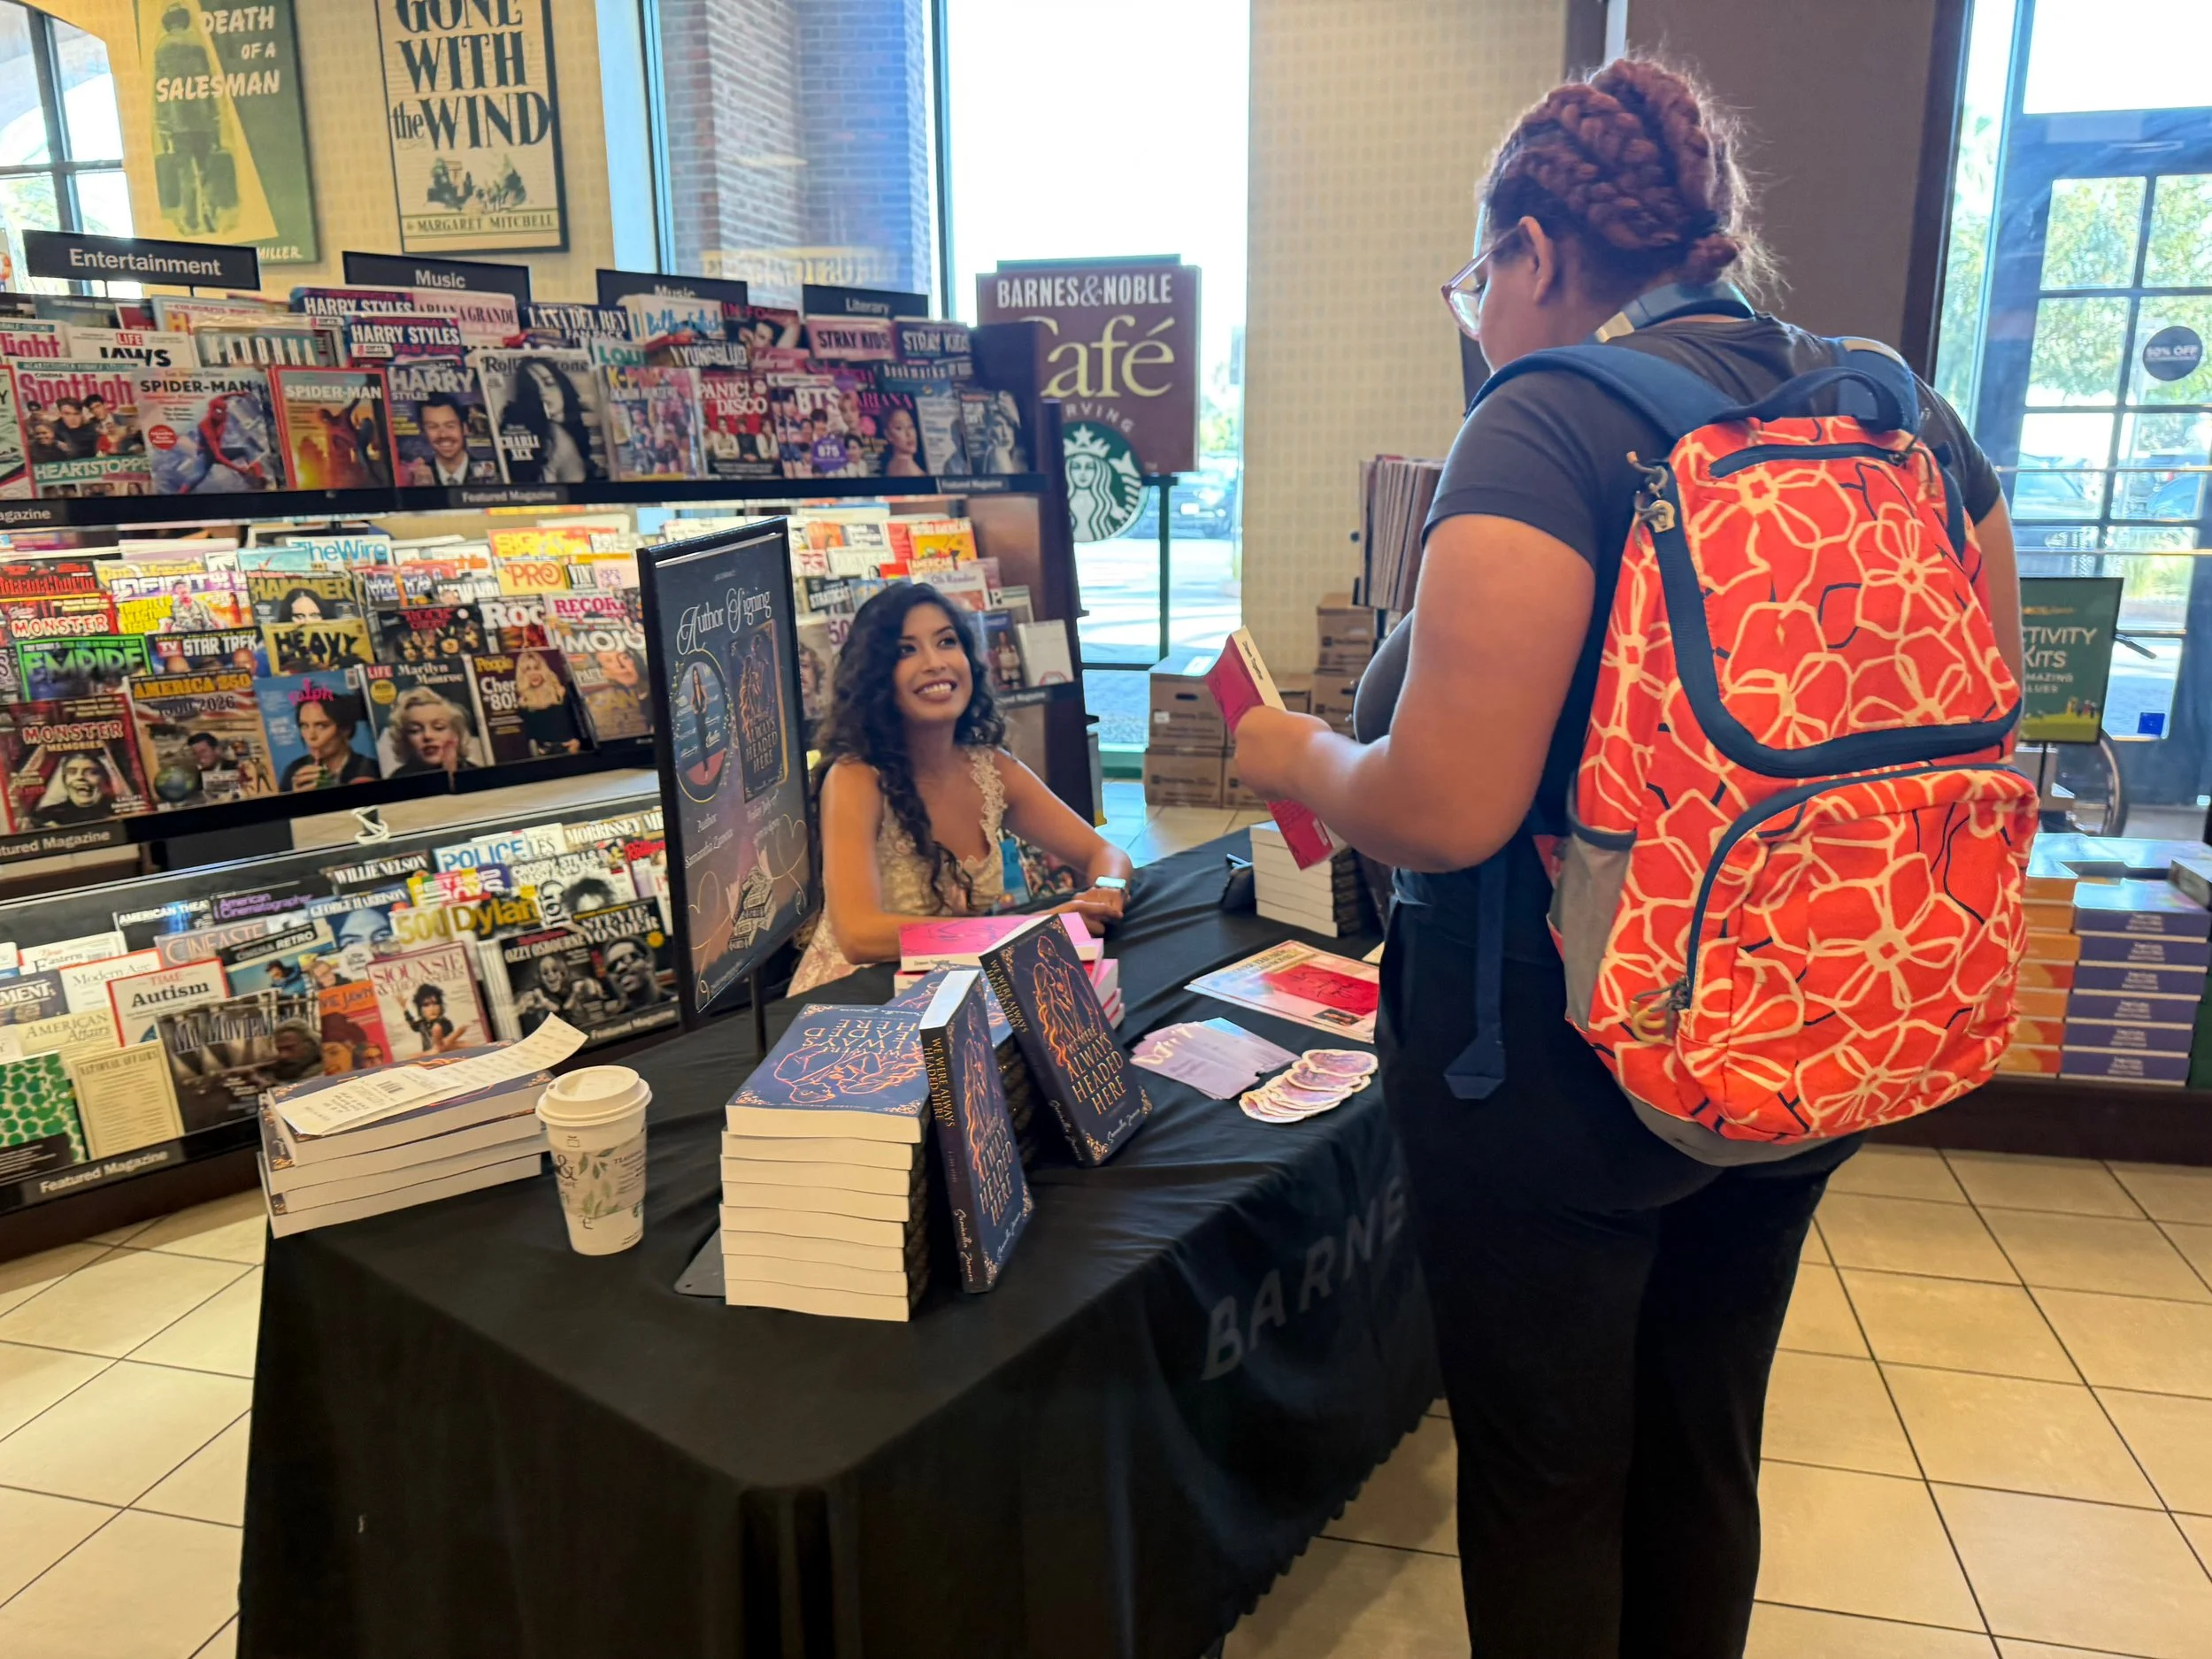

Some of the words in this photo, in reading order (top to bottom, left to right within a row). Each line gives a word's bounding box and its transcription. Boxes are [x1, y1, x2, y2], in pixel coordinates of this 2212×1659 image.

[198, 7, 274, 35] DEATH
[241, 42, 261, 60] OF
[264, 42, 277, 59] A
[399, 31, 526, 94] WITH
[155, 70, 280, 103] SALESMAN
[393, 107, 426, 142] the
[421, 91, 551, 151] WIND
[417, 216, 483, 233] MARGARET
[489, 213, 554, 229] MITCHELL
[70, 248, 222, 278] Entertainment
[256, 245, 303, 261] MILLER
[415, 269, 466, 289] Music
[996, 273, 1173, 309] BARNES&NOBLE
[303, 296, 357, 316] HARRY
[845, 296, 892, 315] Literary
[116, 333, 143, 346] LIFE
[350, 324, 405, 343] HARRY
[408, 326, 461, 345] STYLES
[140, 380, 251, 392] SPIDER-MAN
[284, 384, 382, 399] SPIDER-MAN
[388, 365, 474, 395] HARRY
[716, 397, 768, 416] DISCO
[12, 614, 109, 638] MONSTER
[676, 602, 725, 656] Author
[726, 588, 772, 634] Signing
[160, 641, 178, 652] TV
[182, 637, 221, 657] STAR
[222, 634, 259, 652] TREK
[565, 629, 646, 653] MOJO
[397, 662, 450, 678] Marilyn
[2023, 649, 2068, 669] KITS
[367, 665, 393, 680] LIFE
[416, 672, 465, 686] Monroe
[134, 675, 215, 699] AMERICA
[480, 677, 516, 695] Cher
[22, 720, 124, 745] MONSTER
[42, 829, 111, 849] Magazine
[442, 839, 525, 872] POLICE
[219, 893, 272, 910] American
[119, 908, 176, 926] AMERICAN
[451, 898, 541, 936] Dylan
[275, 931, 315, 950] RETRO
[131, 979, 211, 1009] Autism
[986, 969, 1007, 1006] HEADED
[997, 974, 1014, 999] WERE
[1008, 1001, 1029, 1033] ALWAYS
[26, 1011, 109, 1040] AMERICAN
[835, 1018, 918, 1032] HERE
[932, 1037, 944, 1054] WE
[1066, 1040, 1080, 1055] WE
[1079, 1025, 1099, 1046] WERE
[923, 1047, 940, 1091] HEADED
[1067, 1032, 1114, 1082] ALWAYS
[934, 1056, 949, 1086] WERE
[1071, 1050, 1125, 1104] HEADED
[931, 1094, 944, 1120] HERE
[1091, 1074, 1127, 1116] HERE
[940, 1088, 956, 1128] ALWAYS
[40, 1167, 102, 1194] Featured
[104, 1149, 169, 1177] Magazine
[979, 1141, 1013, 1215] HEADED
[990, 1171, 1014, 1227] HERE
